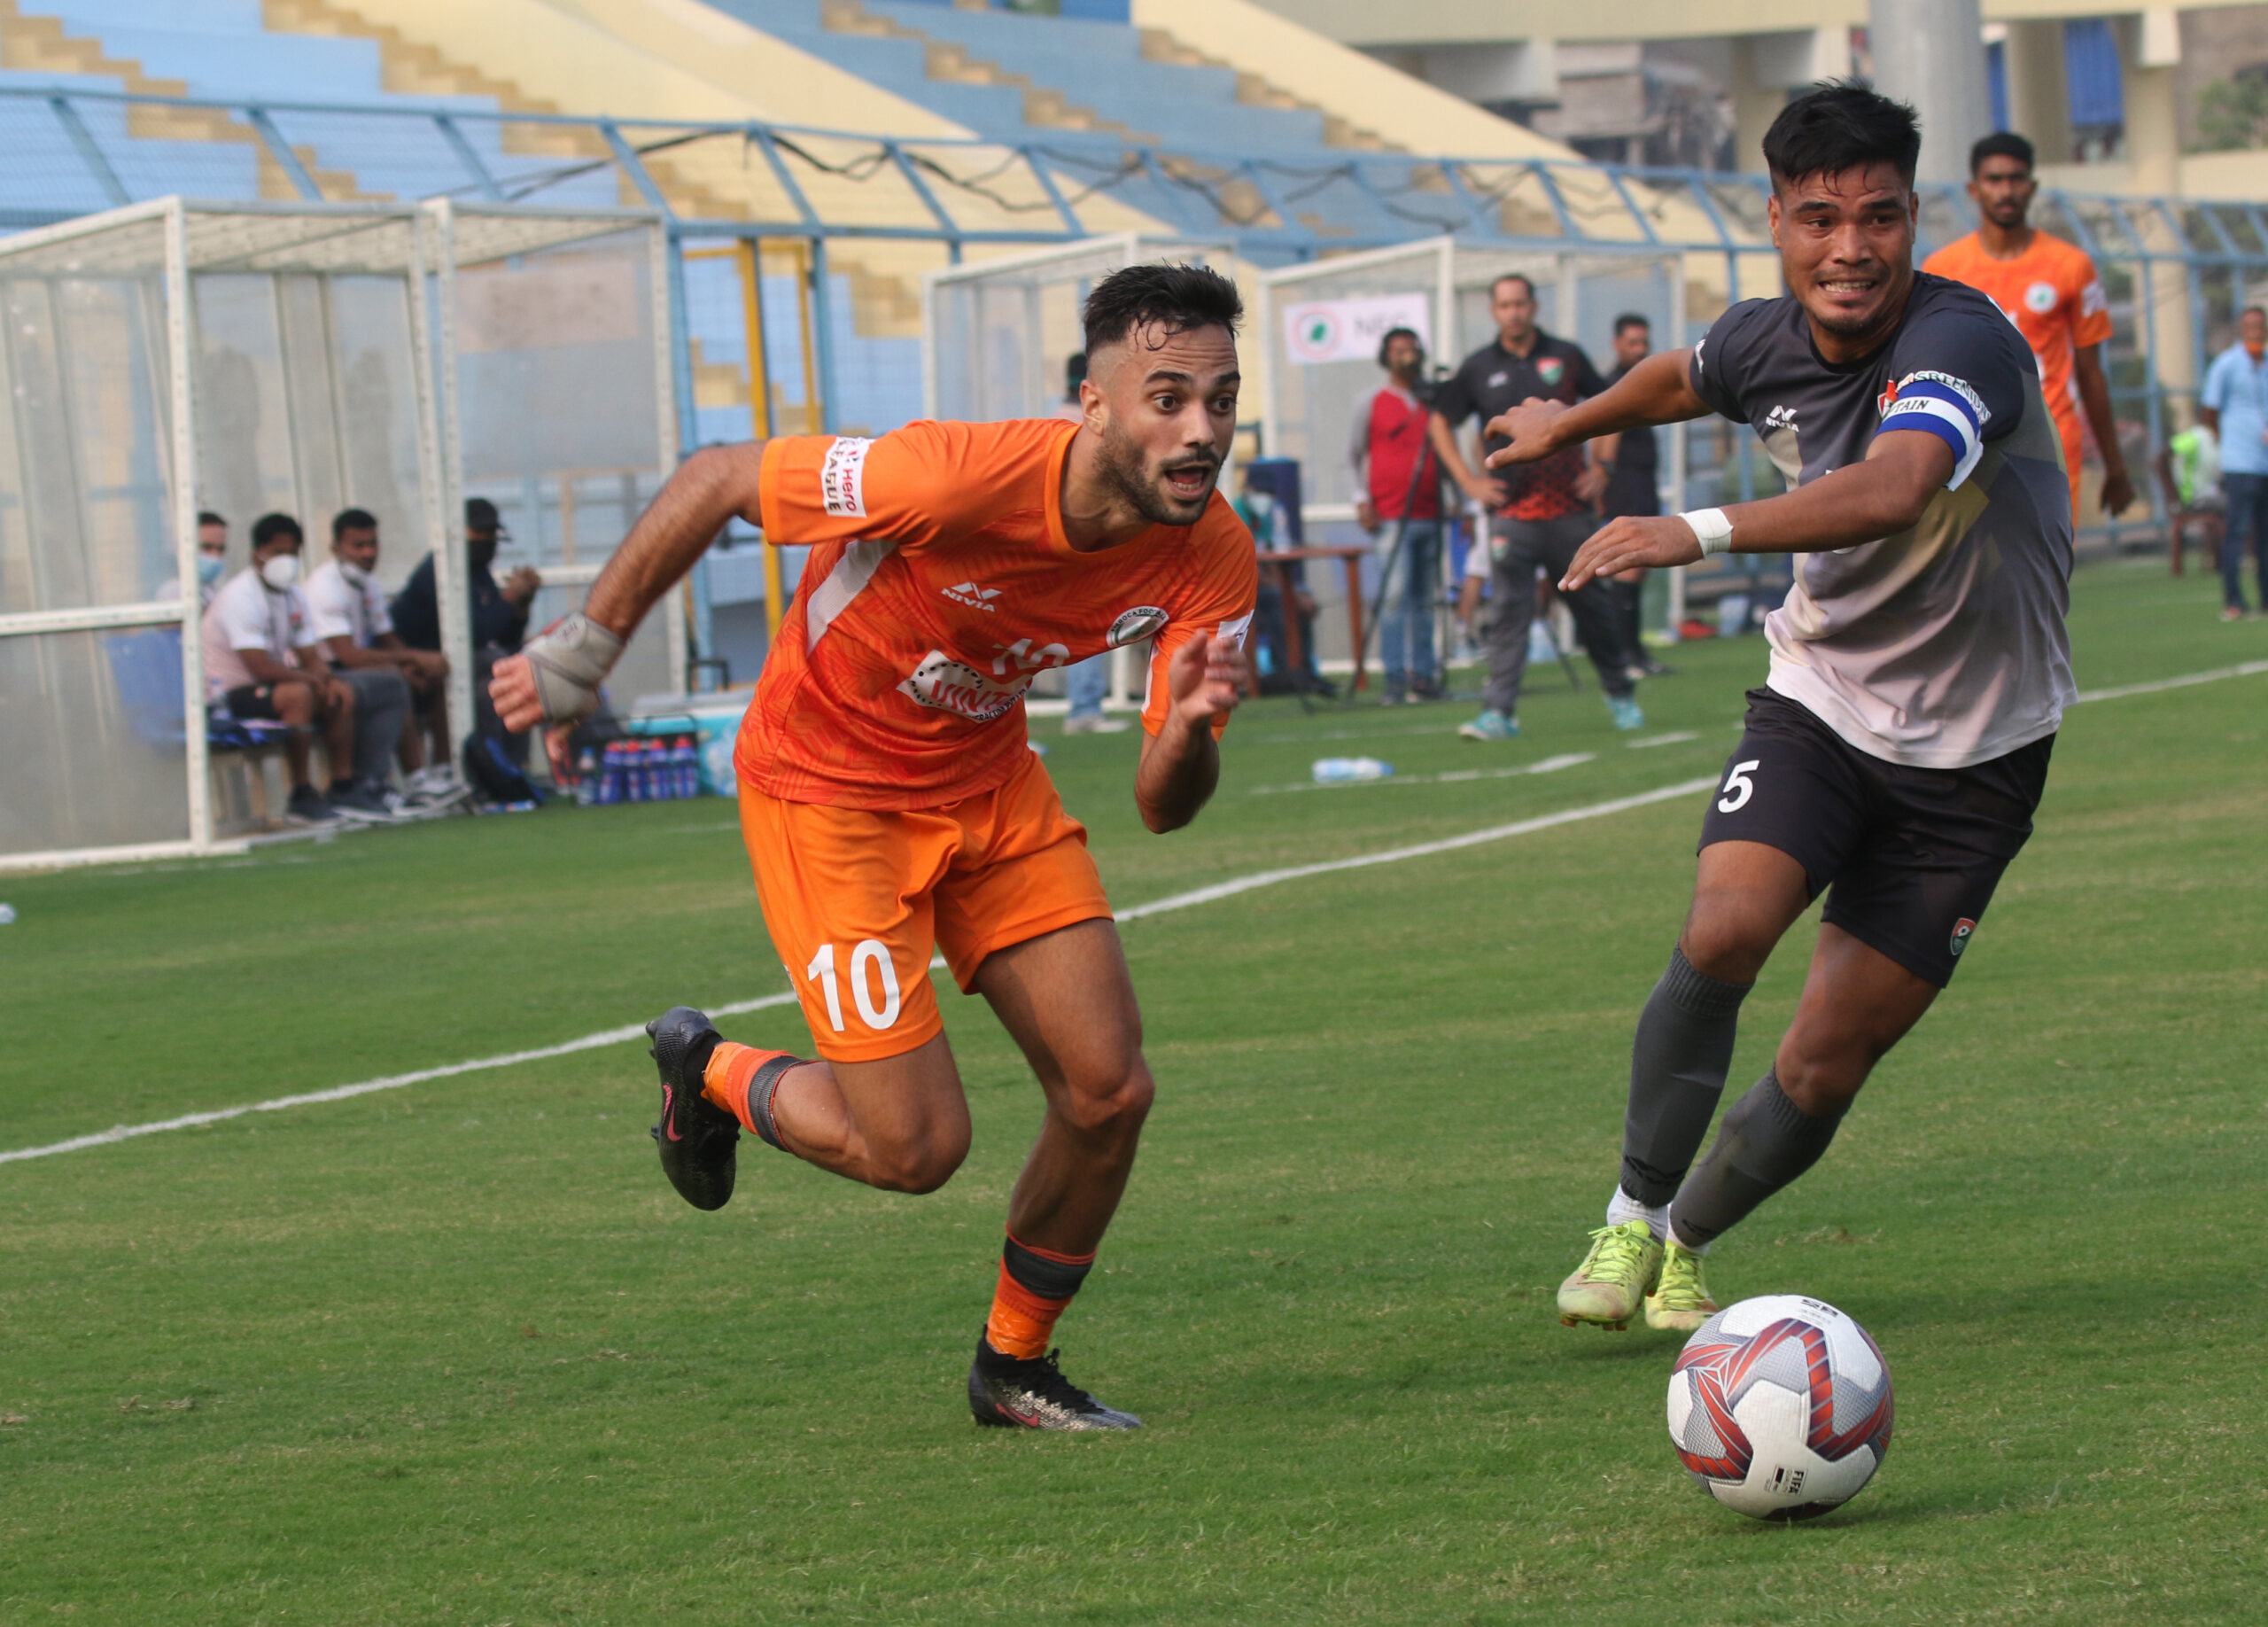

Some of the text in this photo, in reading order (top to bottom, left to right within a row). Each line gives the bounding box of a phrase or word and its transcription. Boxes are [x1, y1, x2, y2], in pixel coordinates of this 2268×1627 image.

[1890, 400, 1929, 413] TAIN
[843, 468, 857, 511] Hero
[941, 588, 995, 612] NIVIA
[1718, 759, 1759, 814] 5
[807, 939, 900, 1031] 10
[1788, 1470, 1805, 1494] FIFA
